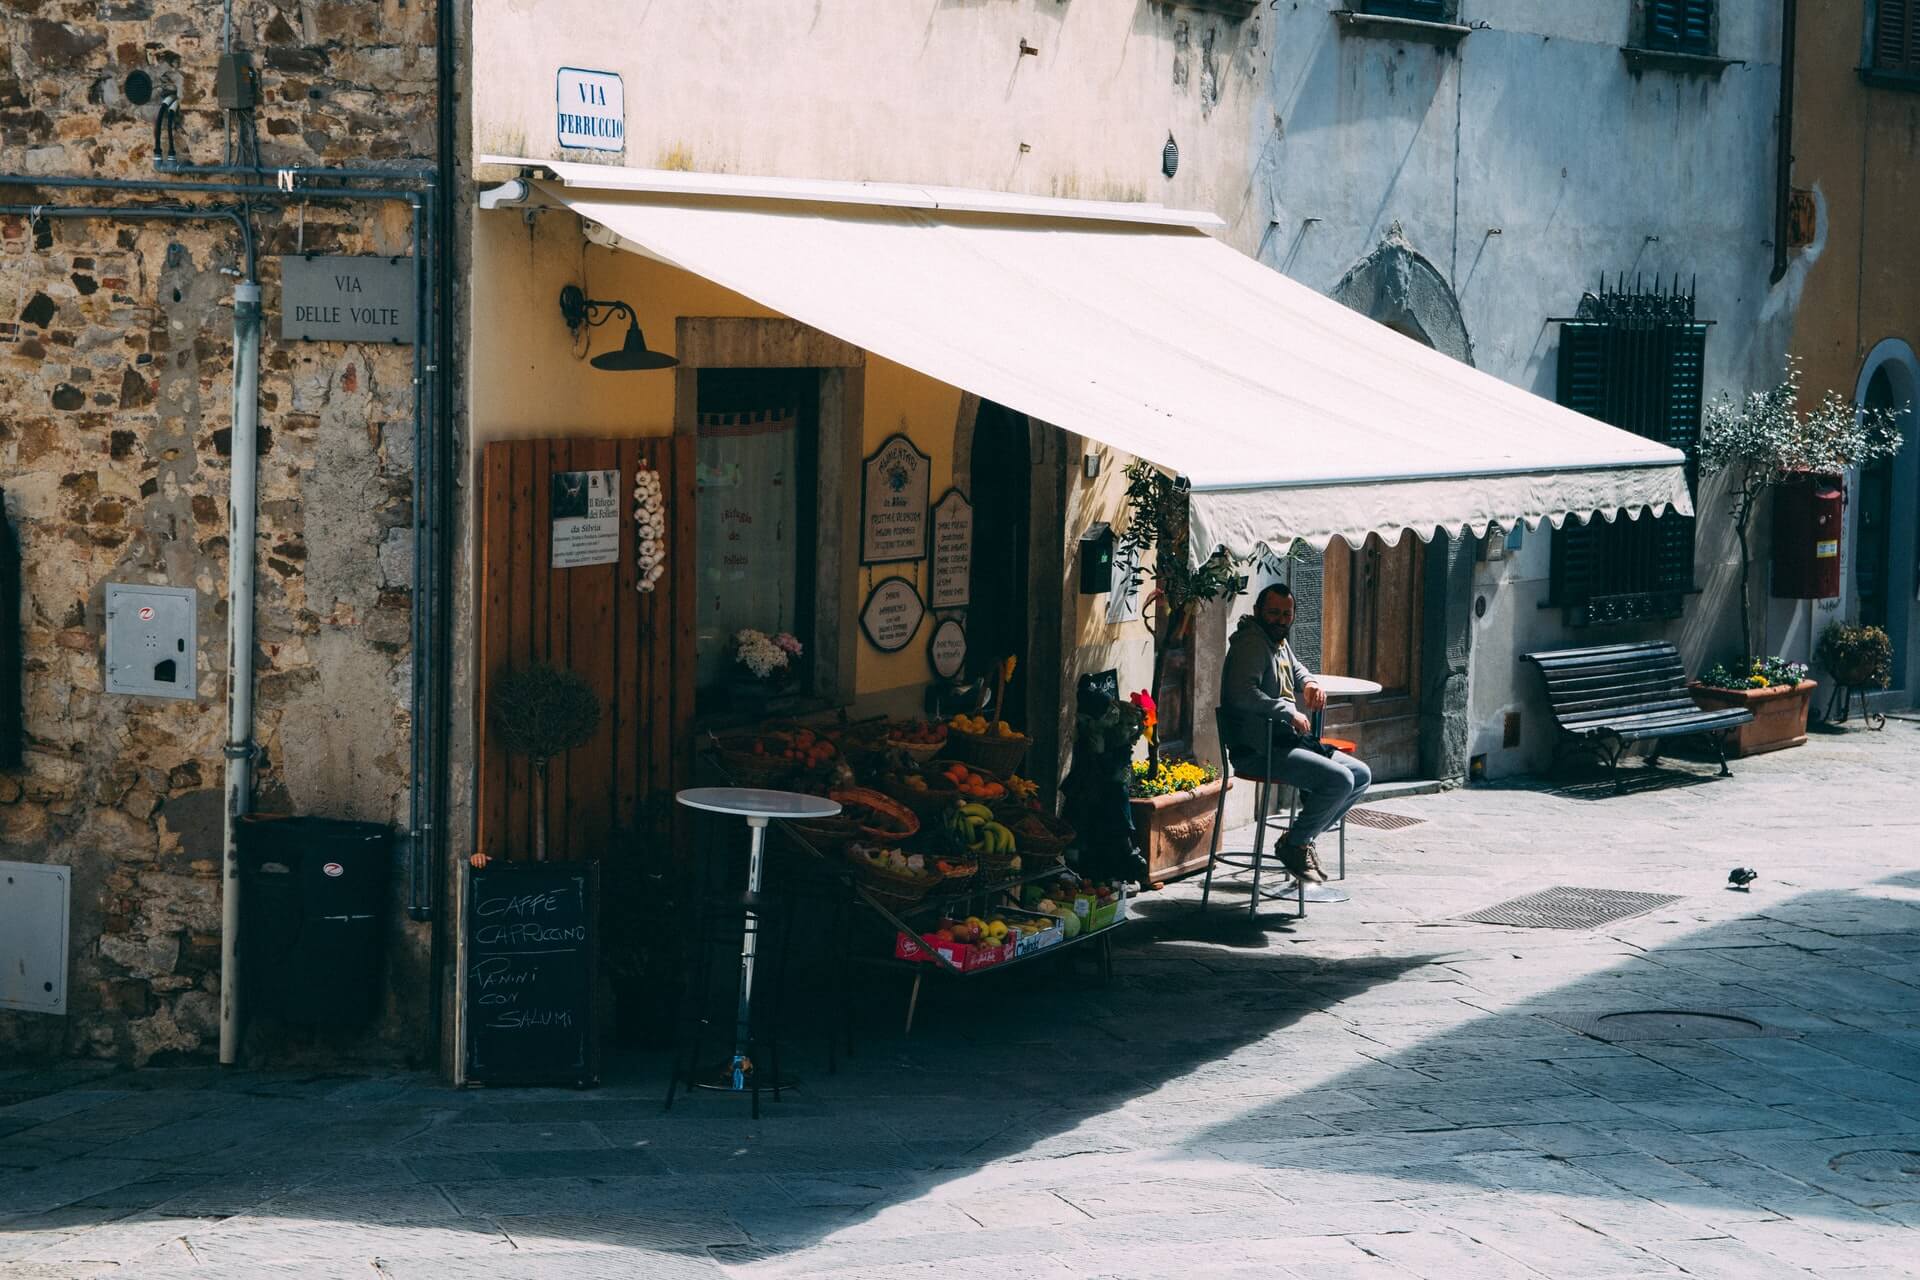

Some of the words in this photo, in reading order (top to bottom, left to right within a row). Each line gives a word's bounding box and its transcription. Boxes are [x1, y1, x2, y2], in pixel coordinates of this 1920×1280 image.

[579, 83, 606, 106] VIA
[560, 113, 623, 138] FERRUCCIO
[335, 275, 362, 293] VIA
[296, 306, 341, 323] DELLE
[351, 308, 399, 325] VOLTE
